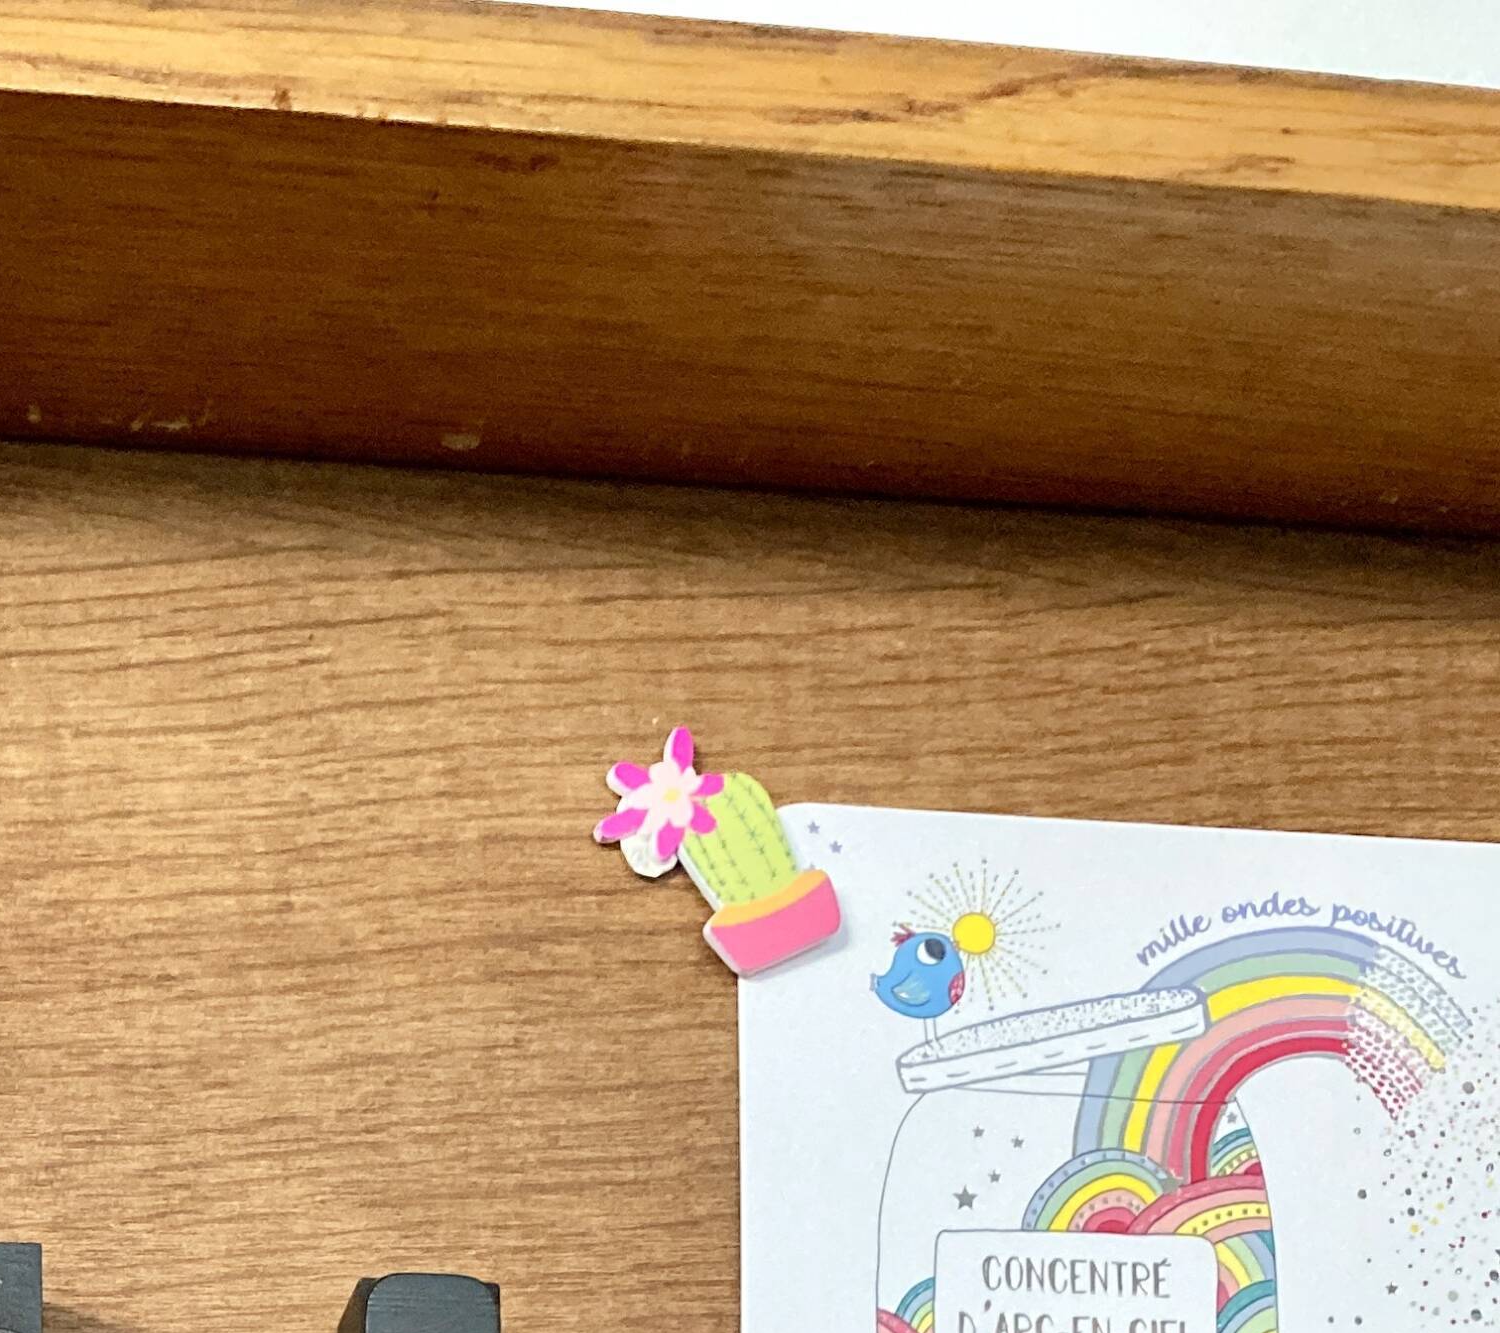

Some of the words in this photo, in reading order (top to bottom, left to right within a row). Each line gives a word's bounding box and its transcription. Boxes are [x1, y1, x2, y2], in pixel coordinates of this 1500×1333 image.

[1137, 914, 1212, 966] mille
[1221, 892, 1320, 924] ondes
[1329, 903, 1467, 980] positives
[982, 1255, 1172, 1299] CONCENTRÉ
